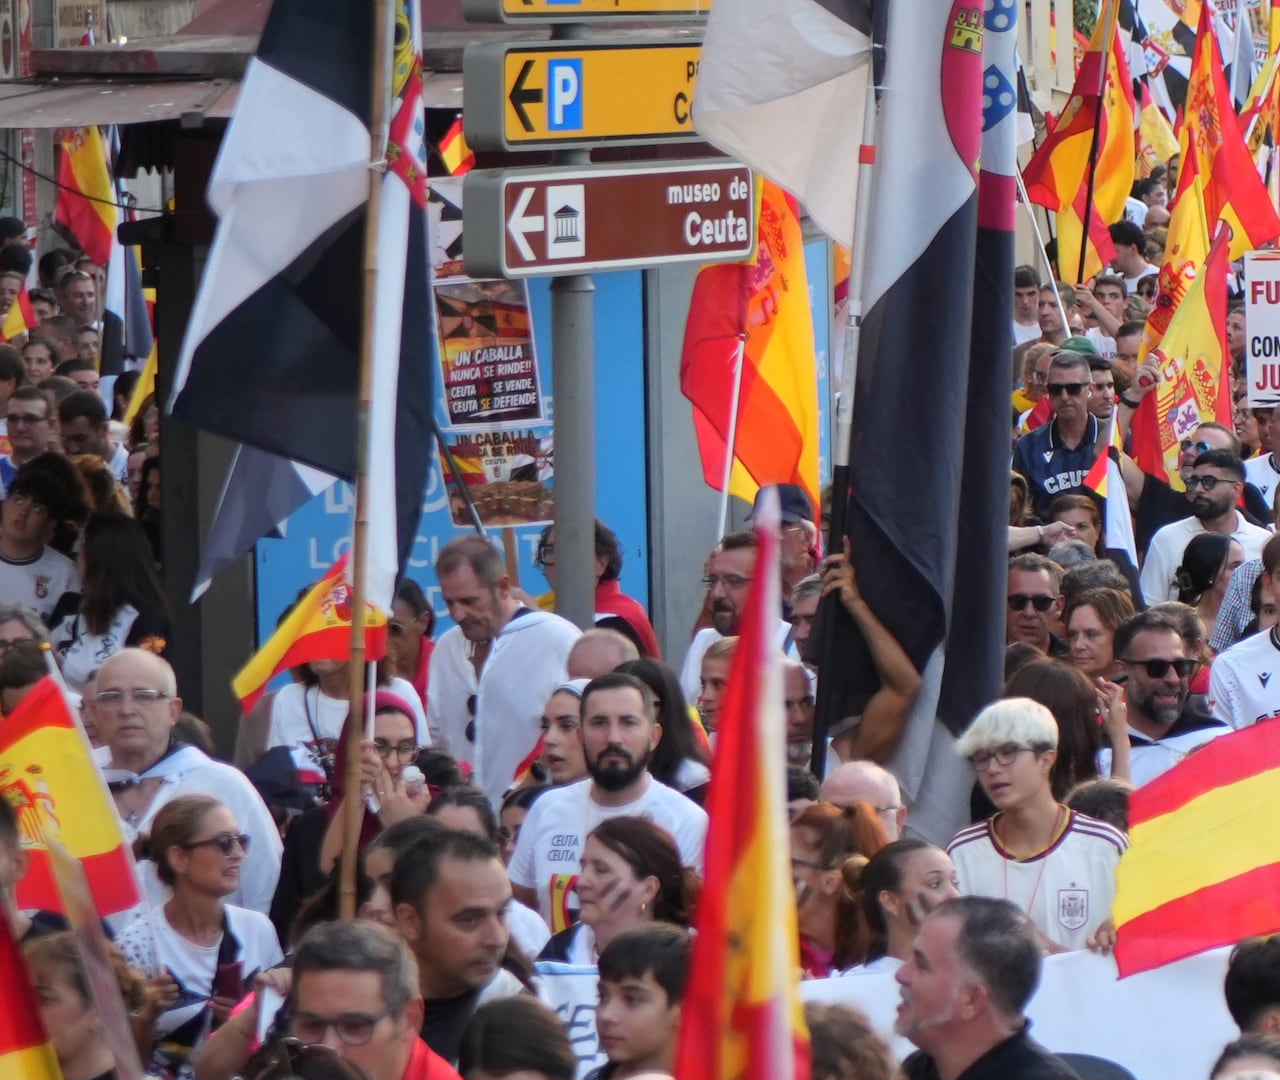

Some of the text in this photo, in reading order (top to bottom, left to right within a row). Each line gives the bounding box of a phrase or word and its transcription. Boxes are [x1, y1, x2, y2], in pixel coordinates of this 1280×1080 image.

[668, 176, 748, 204] museo de
[685, 209, 748, 246] Ceuta
[455, 345, 523, 366] UN CABALLA
[450, 360, 532, 382] NUNCA SE RINDE!!
[451, 385, 477, 398] CEUTA
[492, 380, 504, 393] SE
[452, 392, 537, 414] CEUTA SE DEFIENDE
[456, 430, 536, 447] UN CABALLA
[551, 834, 580, 847] CEUTA
[548, 849, 577, 862] CEUTA
